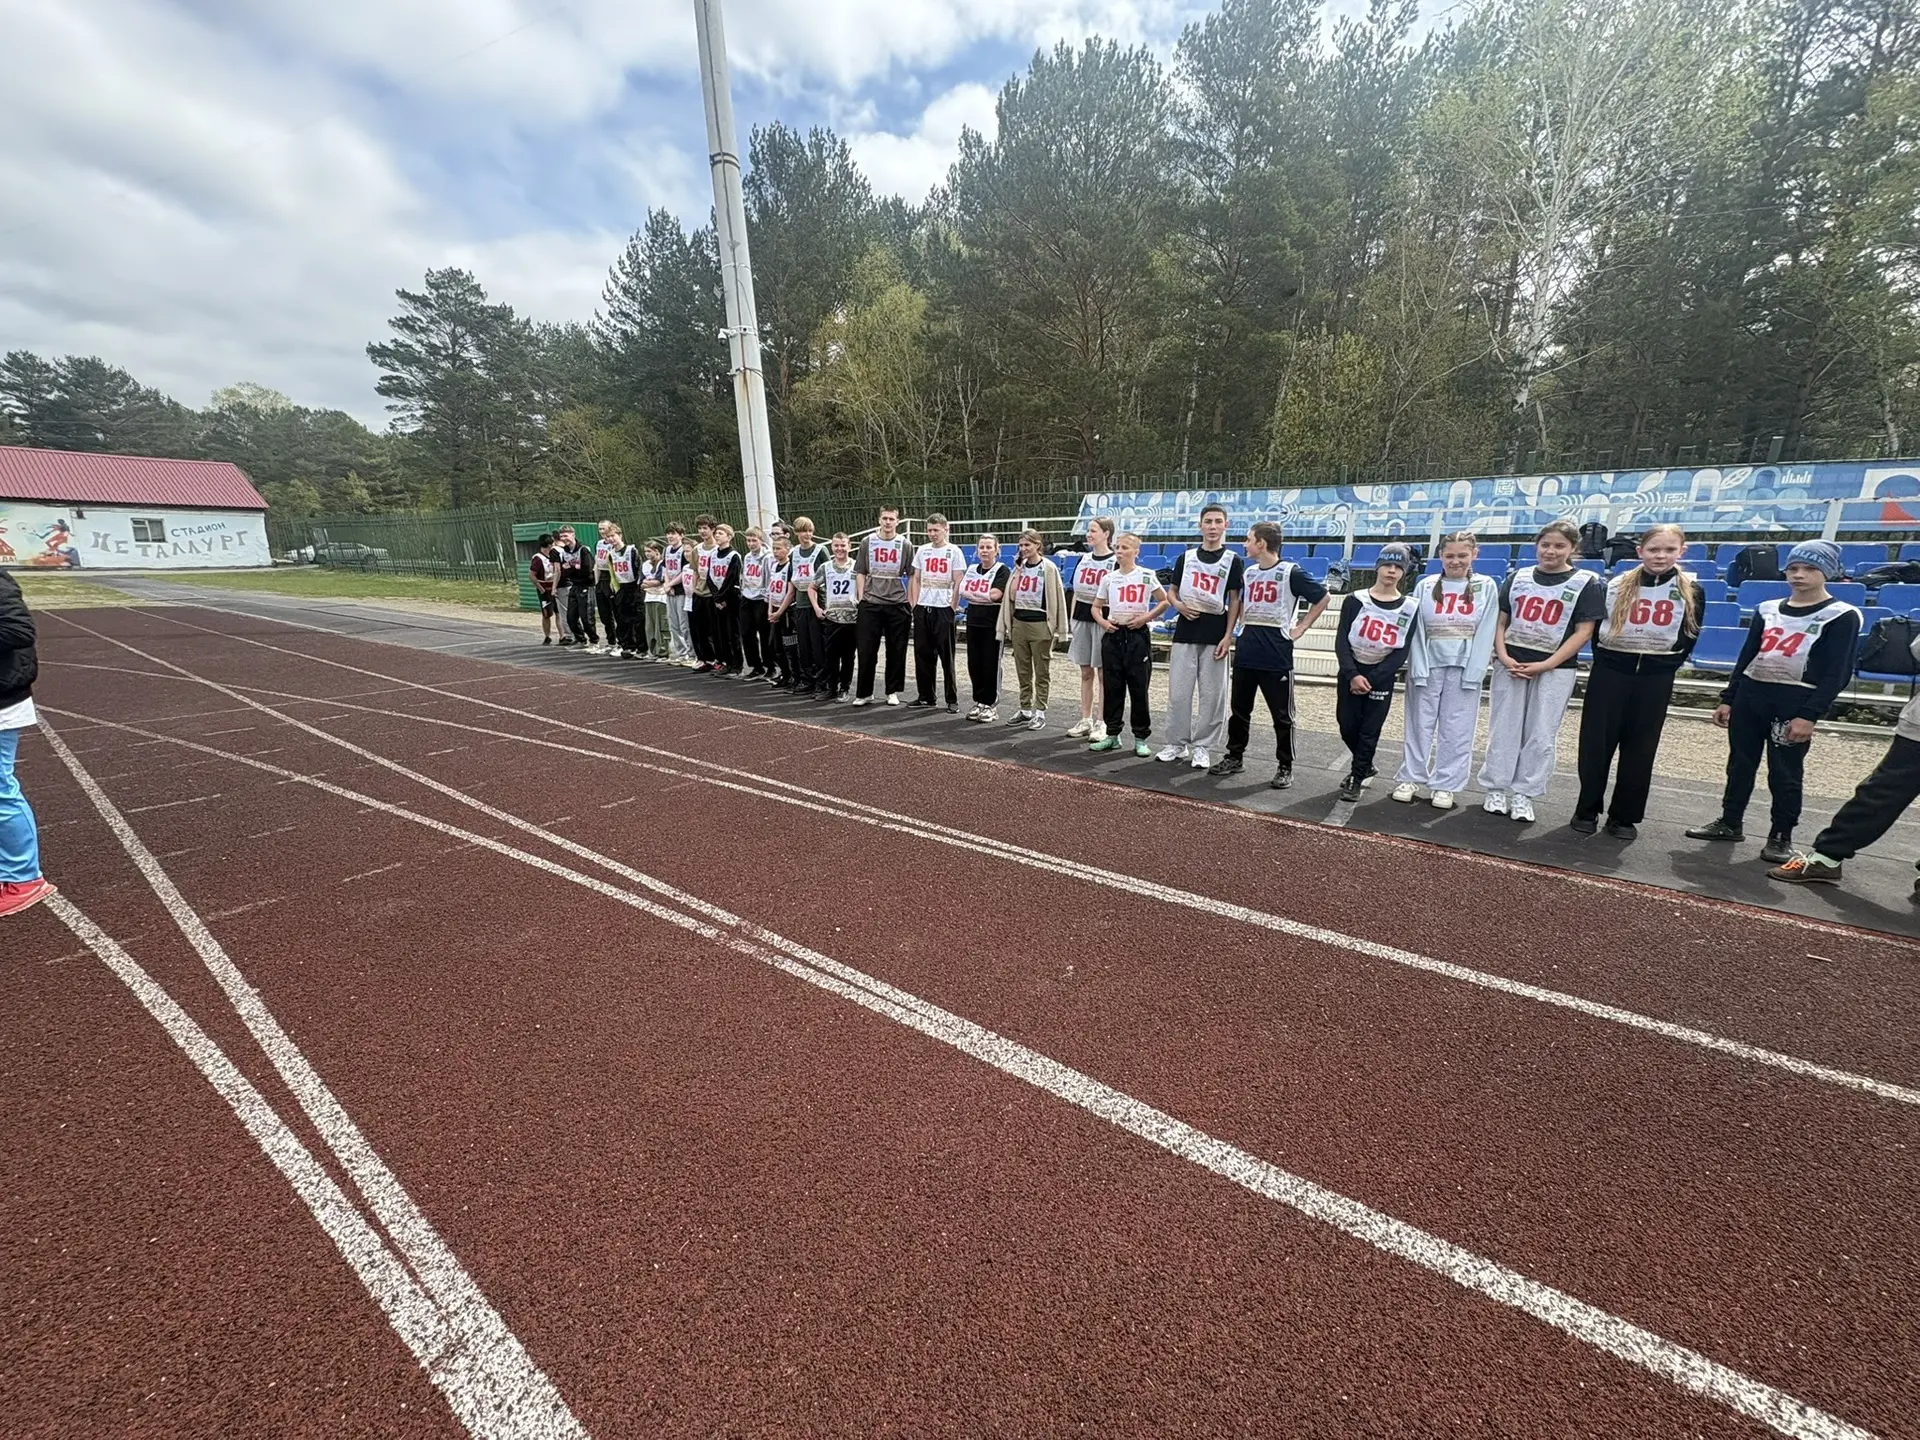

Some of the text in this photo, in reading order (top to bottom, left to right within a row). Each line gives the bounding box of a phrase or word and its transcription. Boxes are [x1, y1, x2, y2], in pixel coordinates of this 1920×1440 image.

[171, 522, 226, 538] СТАДИОН
[91, 530, 248, 559] МЕТАЛЛУРГ
[873, 547, 898, 564] 154
[925, 557, 949, 575] 185
[613, 561, 629, 573] 158
[833, 580, 850, 595] 32
[964, 578, 990, 594] 195
[1117, 583, 1146, 604] 167
[1191, 571, 1220, 595] 157
[1248, 581, 1278, 603] 155
[1435, 592, 1475, 616] 173
[1513, 594, 1564, 626] 160
[1358, 615, 1400, 647] 165
